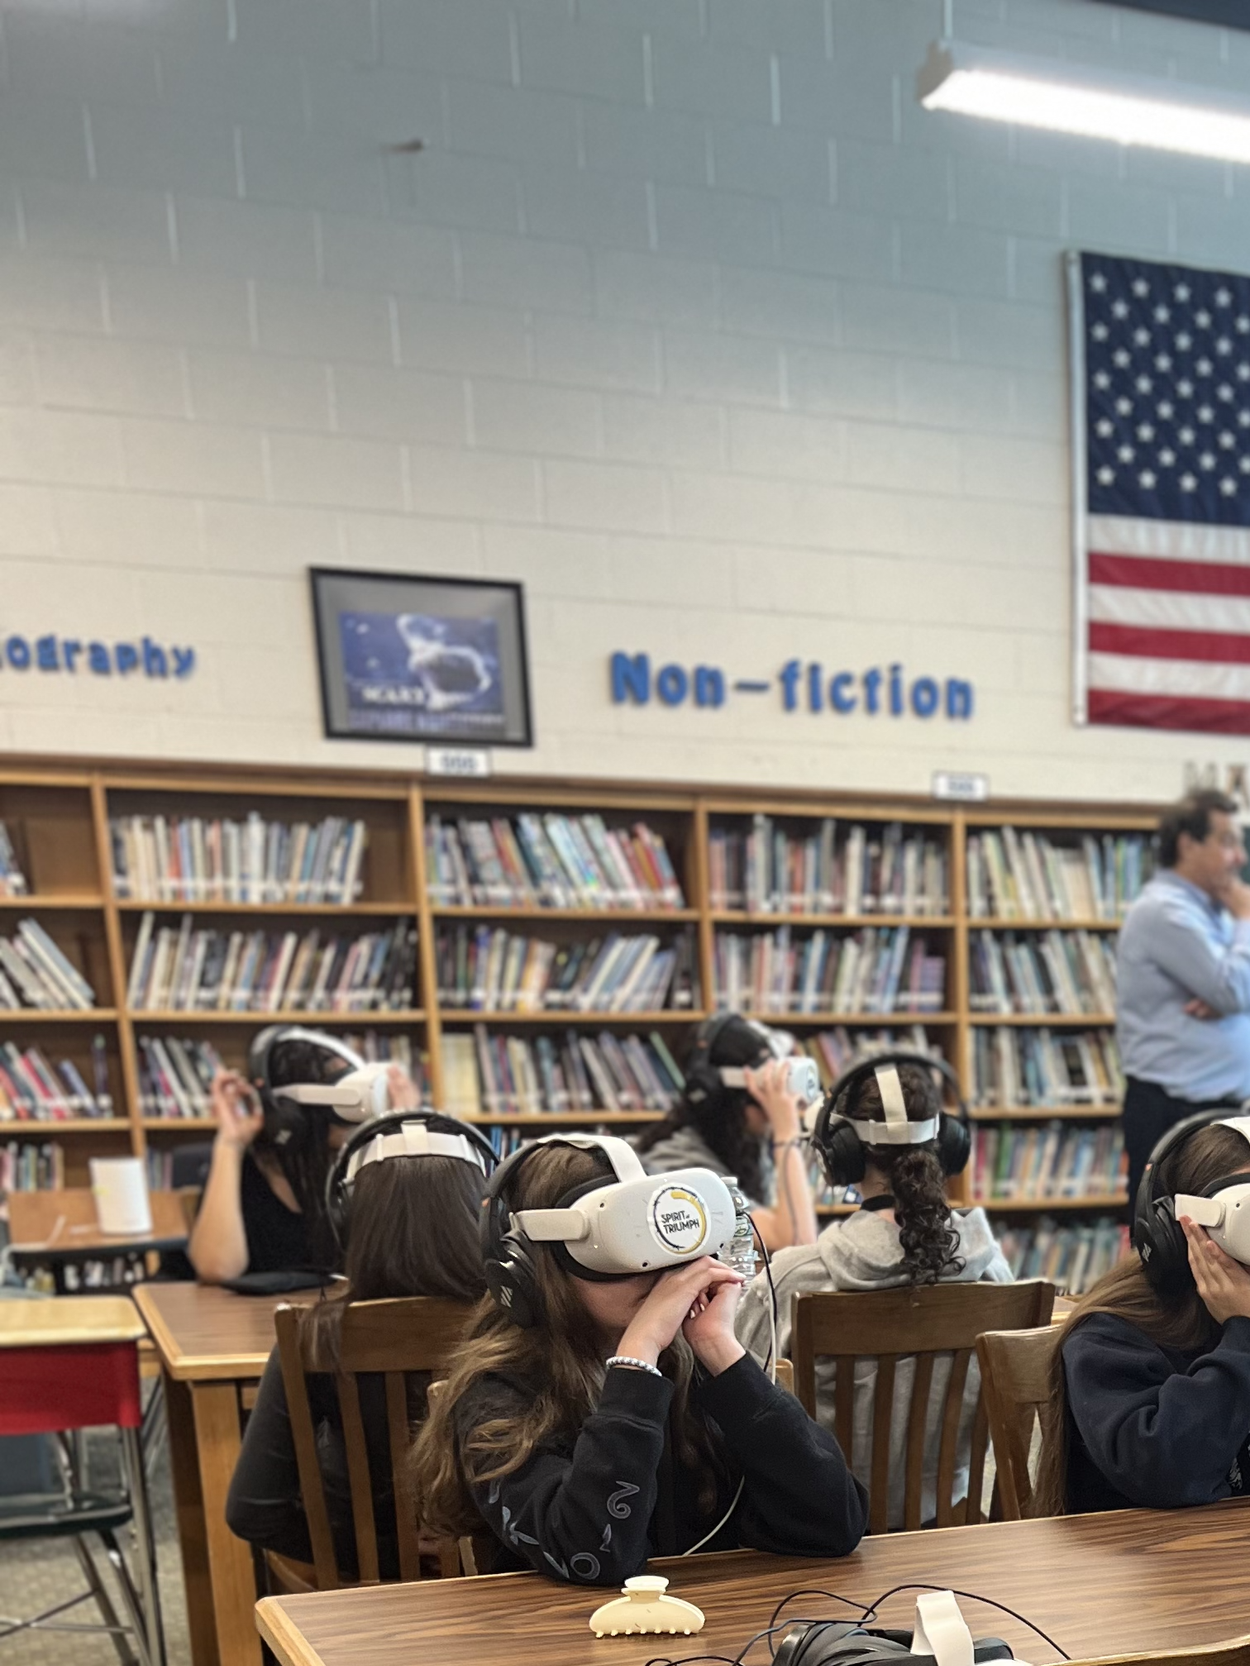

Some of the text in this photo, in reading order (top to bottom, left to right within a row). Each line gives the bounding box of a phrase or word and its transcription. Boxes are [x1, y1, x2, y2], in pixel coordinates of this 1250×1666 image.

[0, 633, 196, 679] ography
[609, 650, 975, 722] Non-fiction
[661, 1210, 686, 1224] SPIRIT
[663, 1218, 700, 1234] TRIUMPH
